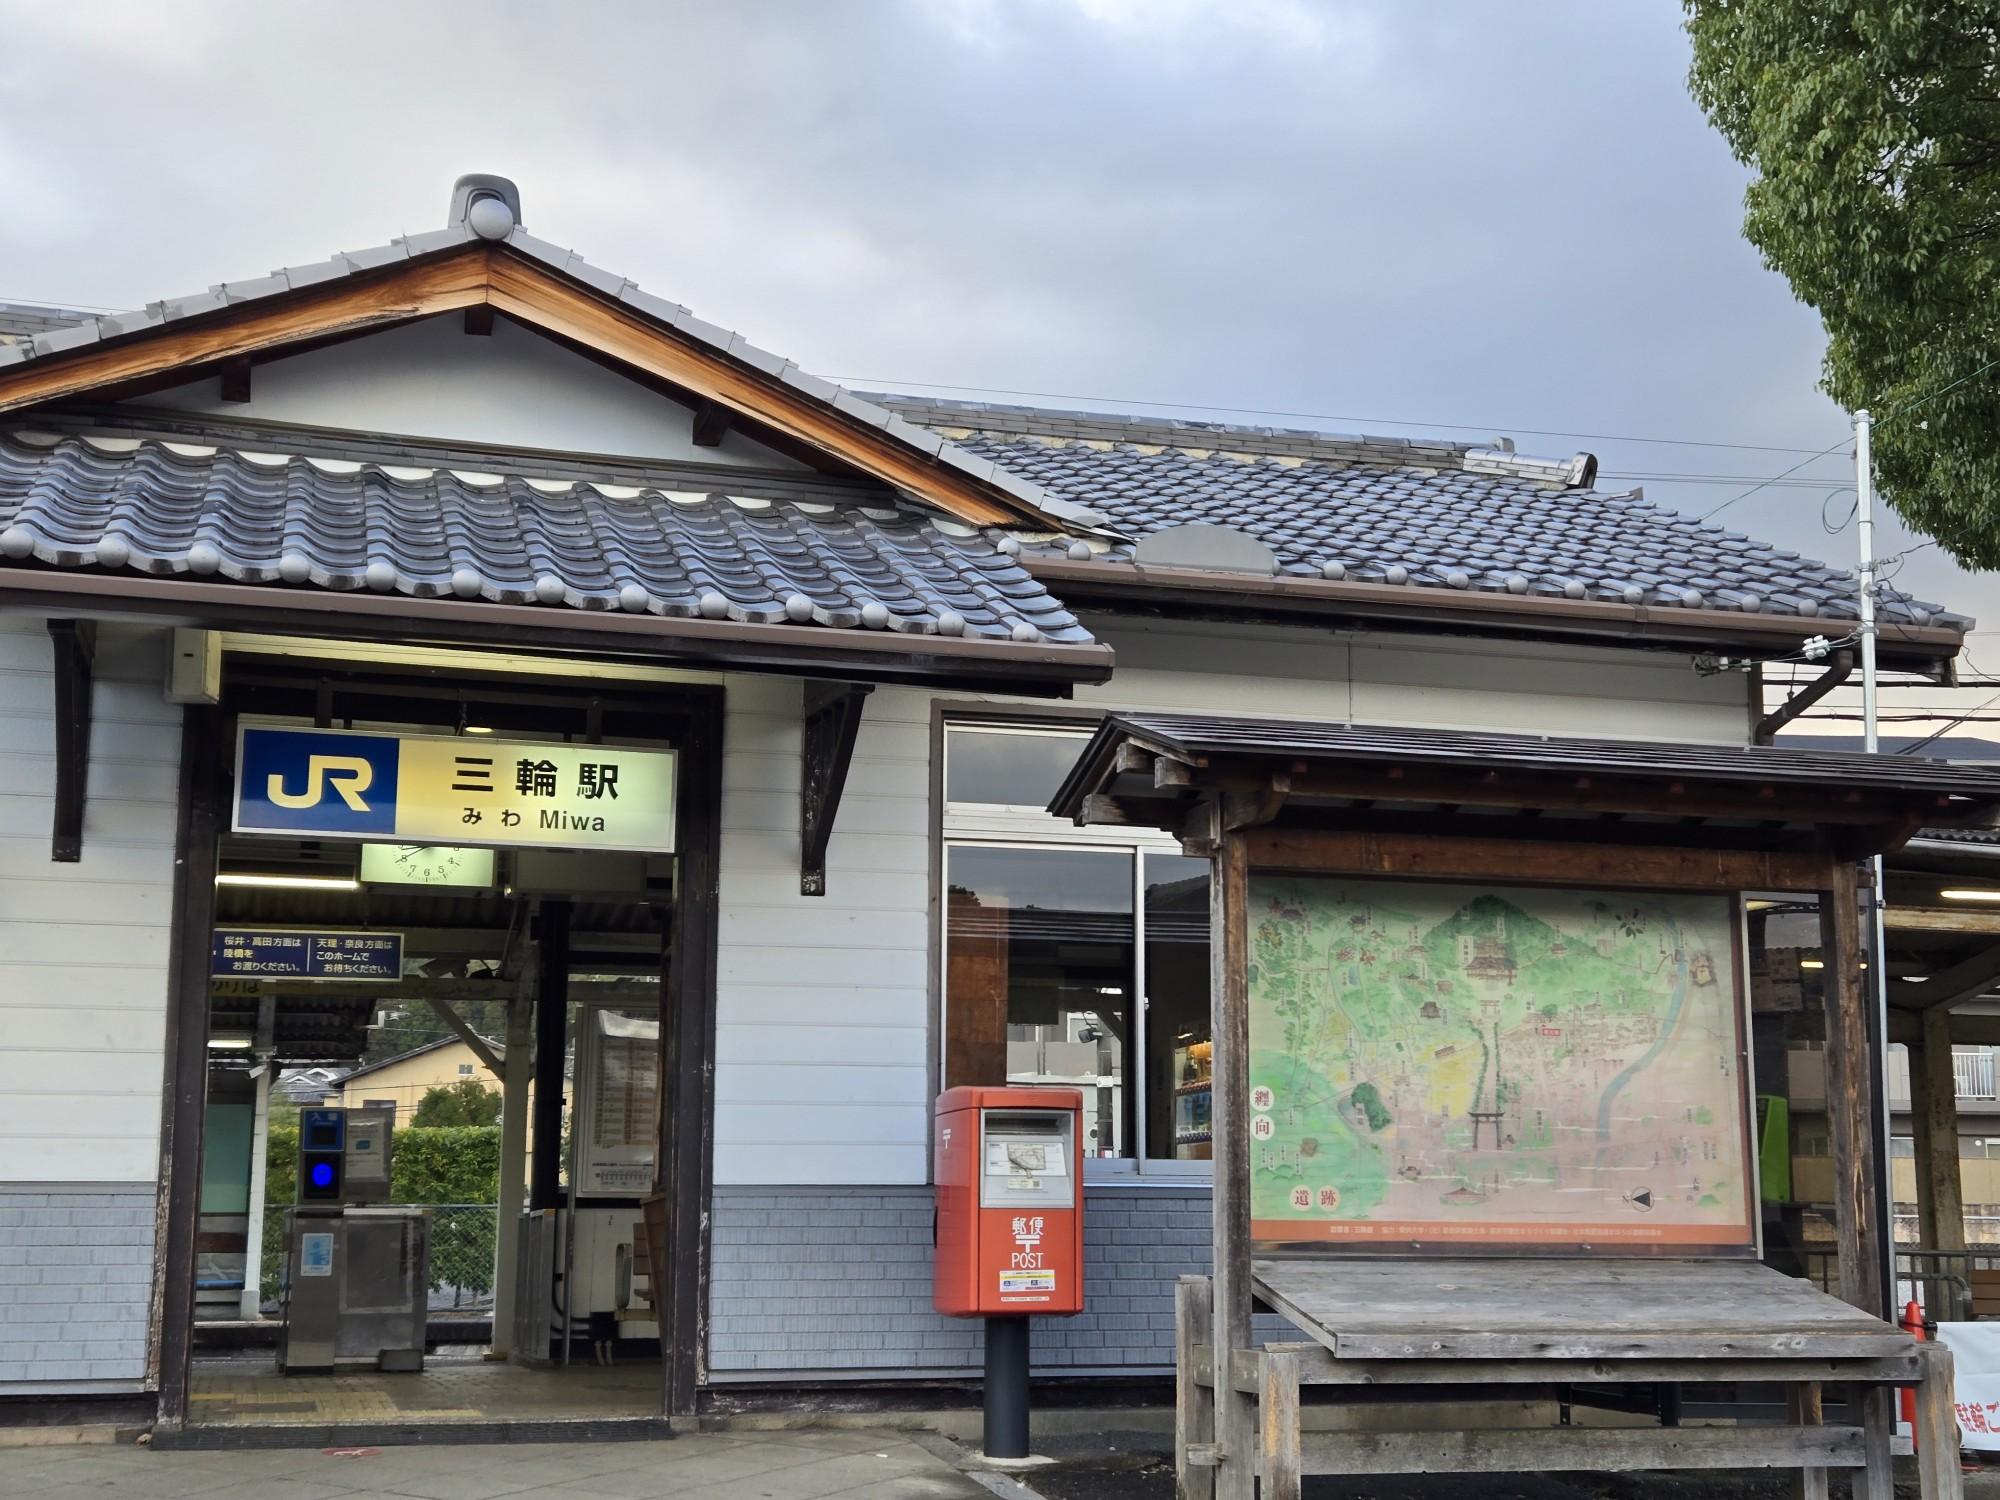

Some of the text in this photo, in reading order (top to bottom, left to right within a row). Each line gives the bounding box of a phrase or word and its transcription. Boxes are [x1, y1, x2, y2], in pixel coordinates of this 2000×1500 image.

[267, 754, 373, 812] JR
[452, 756, 619, 800] 三輪駅
[461, 807, 606, 832] みわ Miwa
[224, 936, 302, 948] 桜井・高田方面は
[316, 938, 392, 949] 天理・奈良方面は
[316, 951, 370, 961] このホームで
[232, 961, 301, 972] お渡りください。
[323, 963, 392, 974] お待ちください。
[1011, 1216, 1044, 1236] 郵便
[1011, 1252, 1044, 1269] POST
